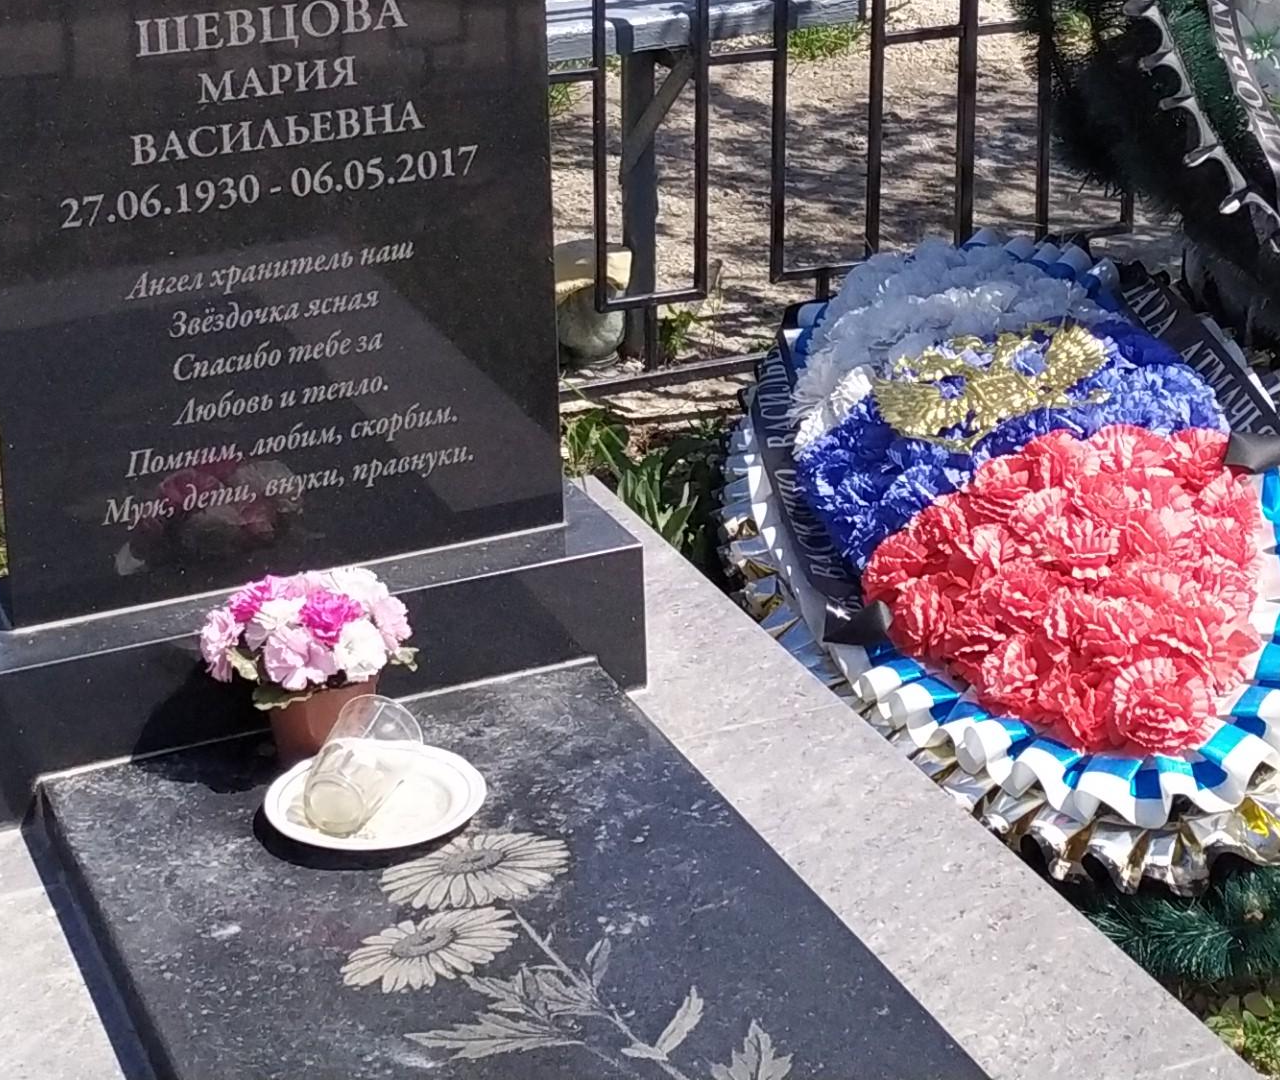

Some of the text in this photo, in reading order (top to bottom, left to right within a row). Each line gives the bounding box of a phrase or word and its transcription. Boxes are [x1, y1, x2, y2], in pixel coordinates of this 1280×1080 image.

[197, 56, 358, 105] МАРИЯ
[131, 101, 425, 166] ВАСИЛЬЕВНА
[61, 173, 260, 229] 27.06.1930
[290, 144, 479, 199] 06.05.2017
[125, 240, 415, 300] Ангел хранитель наш
[168, 291, 379, 340] Звёздочка ясная
[172, 330, 384, 382] Спасибо тебе за
[172, 377, 390, 427] Любовь и тепло.
[125, 404, 458, 479] Помним, любим, скорбим.
[102, 445, 475, 528] Муж, дети, внуки, правнуки.
